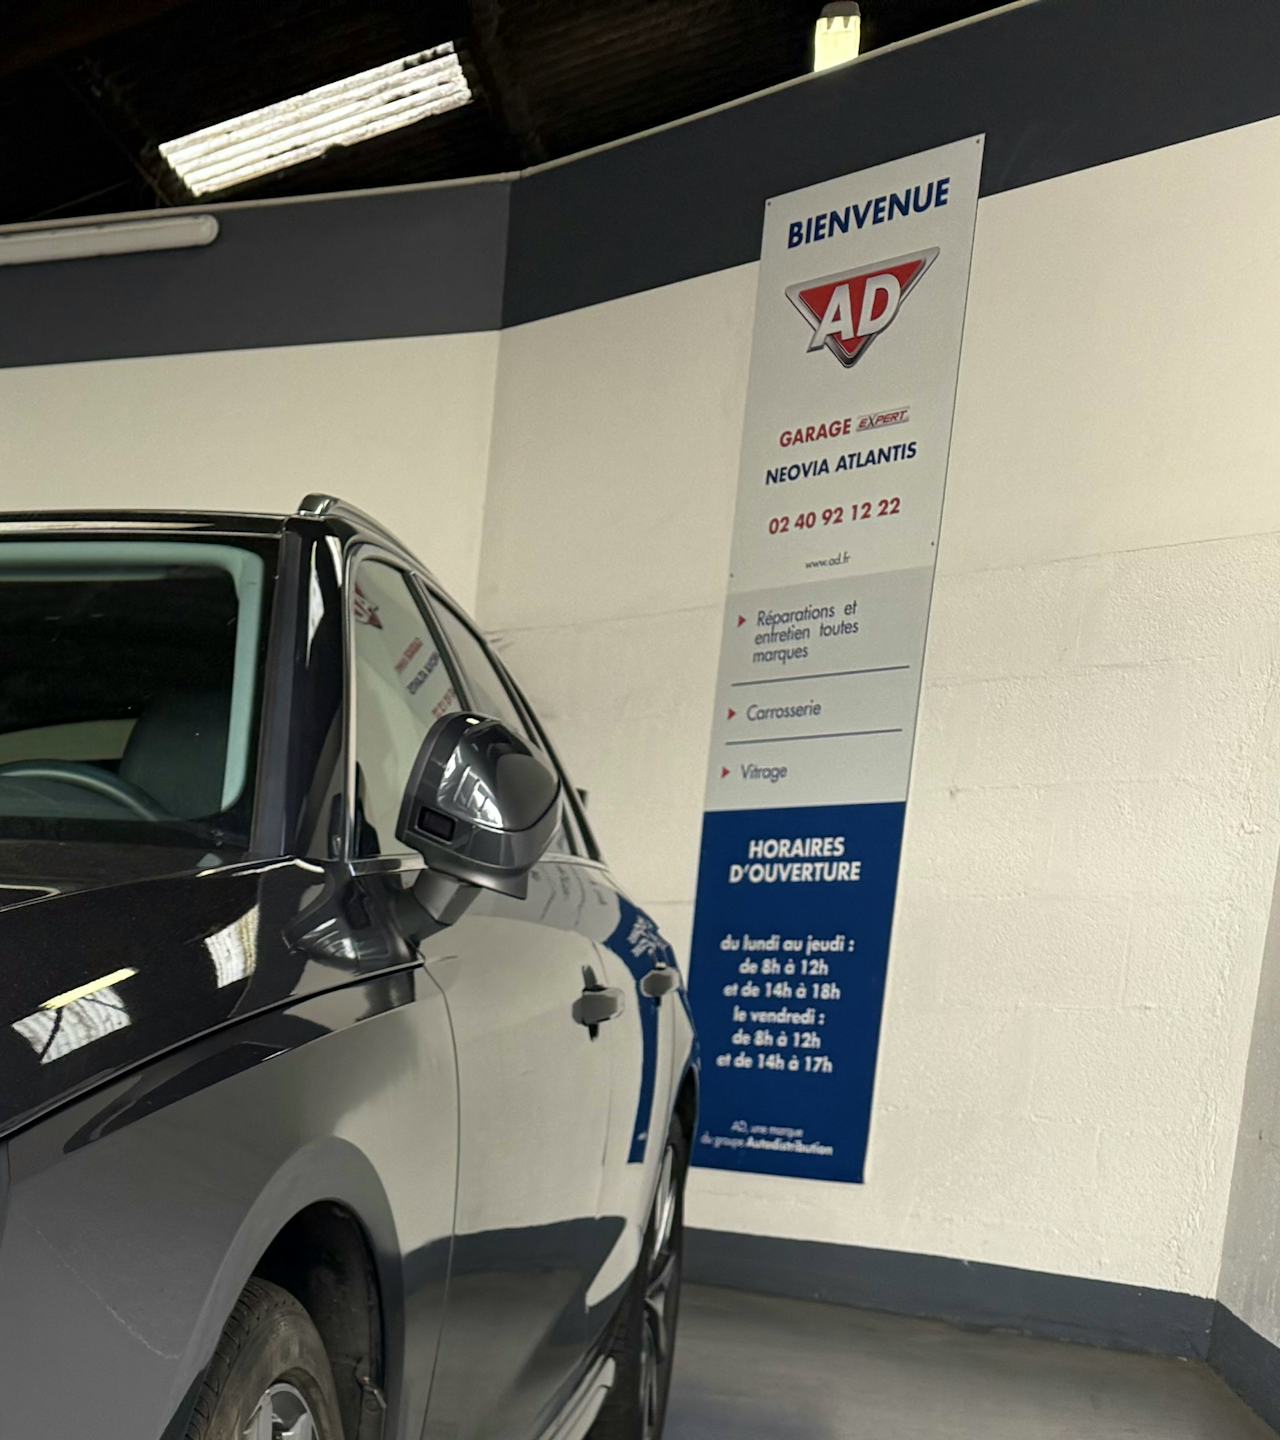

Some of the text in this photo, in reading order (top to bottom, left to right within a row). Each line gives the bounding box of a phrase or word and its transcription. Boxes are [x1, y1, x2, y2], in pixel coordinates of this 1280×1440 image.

[787, 176, 951, 249] BIENVENUE
[807, 273, 902, 353] AD
[779, 418, 852, 448] GARAGE
[765, 441, 918, 486] NEOVIA ATLANTIS
[768, 497, 901, 535] 02 40 92 12 22
[805, 551, 851, 569] www.ad.fr
[757, 600, 858, 634] Réparations et
[754, 620, 860, 645] entretien toutes
[752, 646, 809, 665] marques
[746, 699, 822, 722] Carrosserie
[741, 763, 788, 784] Vitrage
[748, 836, 845, 859] HORAIRES
[720, 933, 740, 951] du
[742, 934, 781, 951] lundi
[782, 939, 803, 951] au
[805, 934, 845, 956] jeudi
[739, 956, 829, 976] de 8h à 12h
[723, 980, 841, 1000] et de 14h à 18h
[733, 1005, 747, 1022] le
[750, 1006, 816, 1025] vendredi
[731, 1028, 821, 1049] de 8h à 12h
[716, 1051, 833, 1073] et de 14h à 17h
